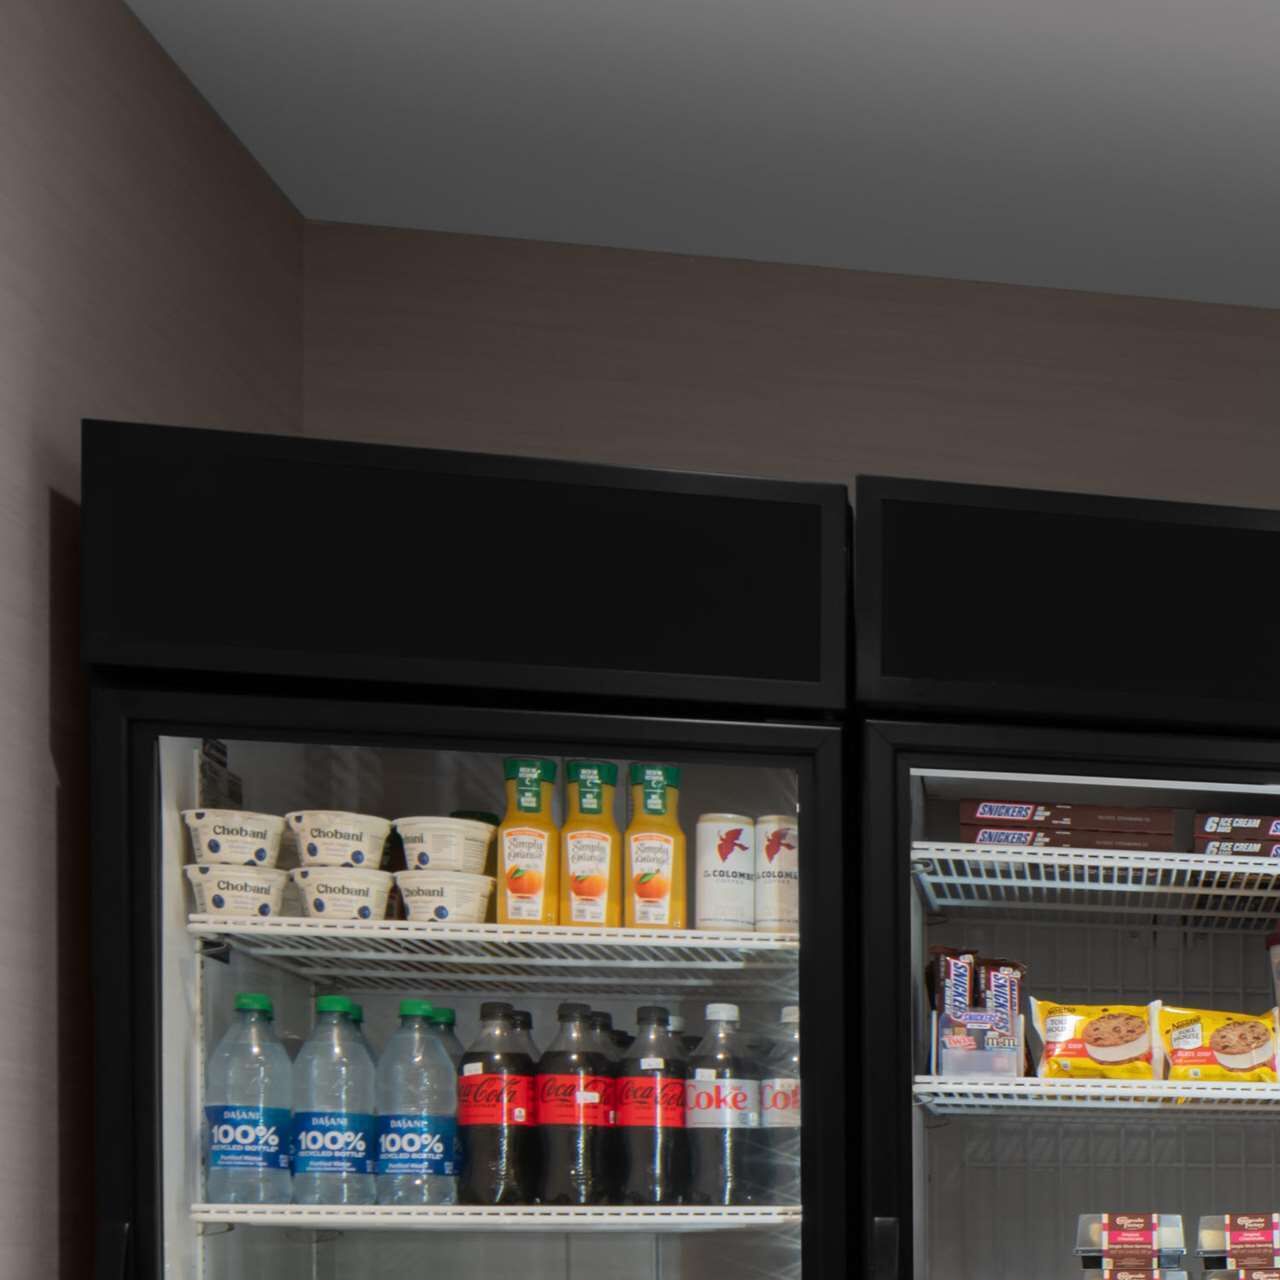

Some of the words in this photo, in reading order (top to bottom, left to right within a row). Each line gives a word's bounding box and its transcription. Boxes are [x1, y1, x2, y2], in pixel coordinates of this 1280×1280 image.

[979, 804, 1030, 818] SNICKERS
[1205, 817, 1219, 832] 6
[213, 825, 267, 840] Chobani
[310, 827, 363, 842] Chobani
[980, 831, 1029, 844] SNICKERS
[217, 880, 271, 895] Chobani
[317, 884, 370, 897] Chobani
[312, 1117, 349, 1126] DASANI
[211, 1125, 279, 1146] 100%
[299, 1131, 366, 1151] 100%
[379, 1133, 444, 1153] 100%
